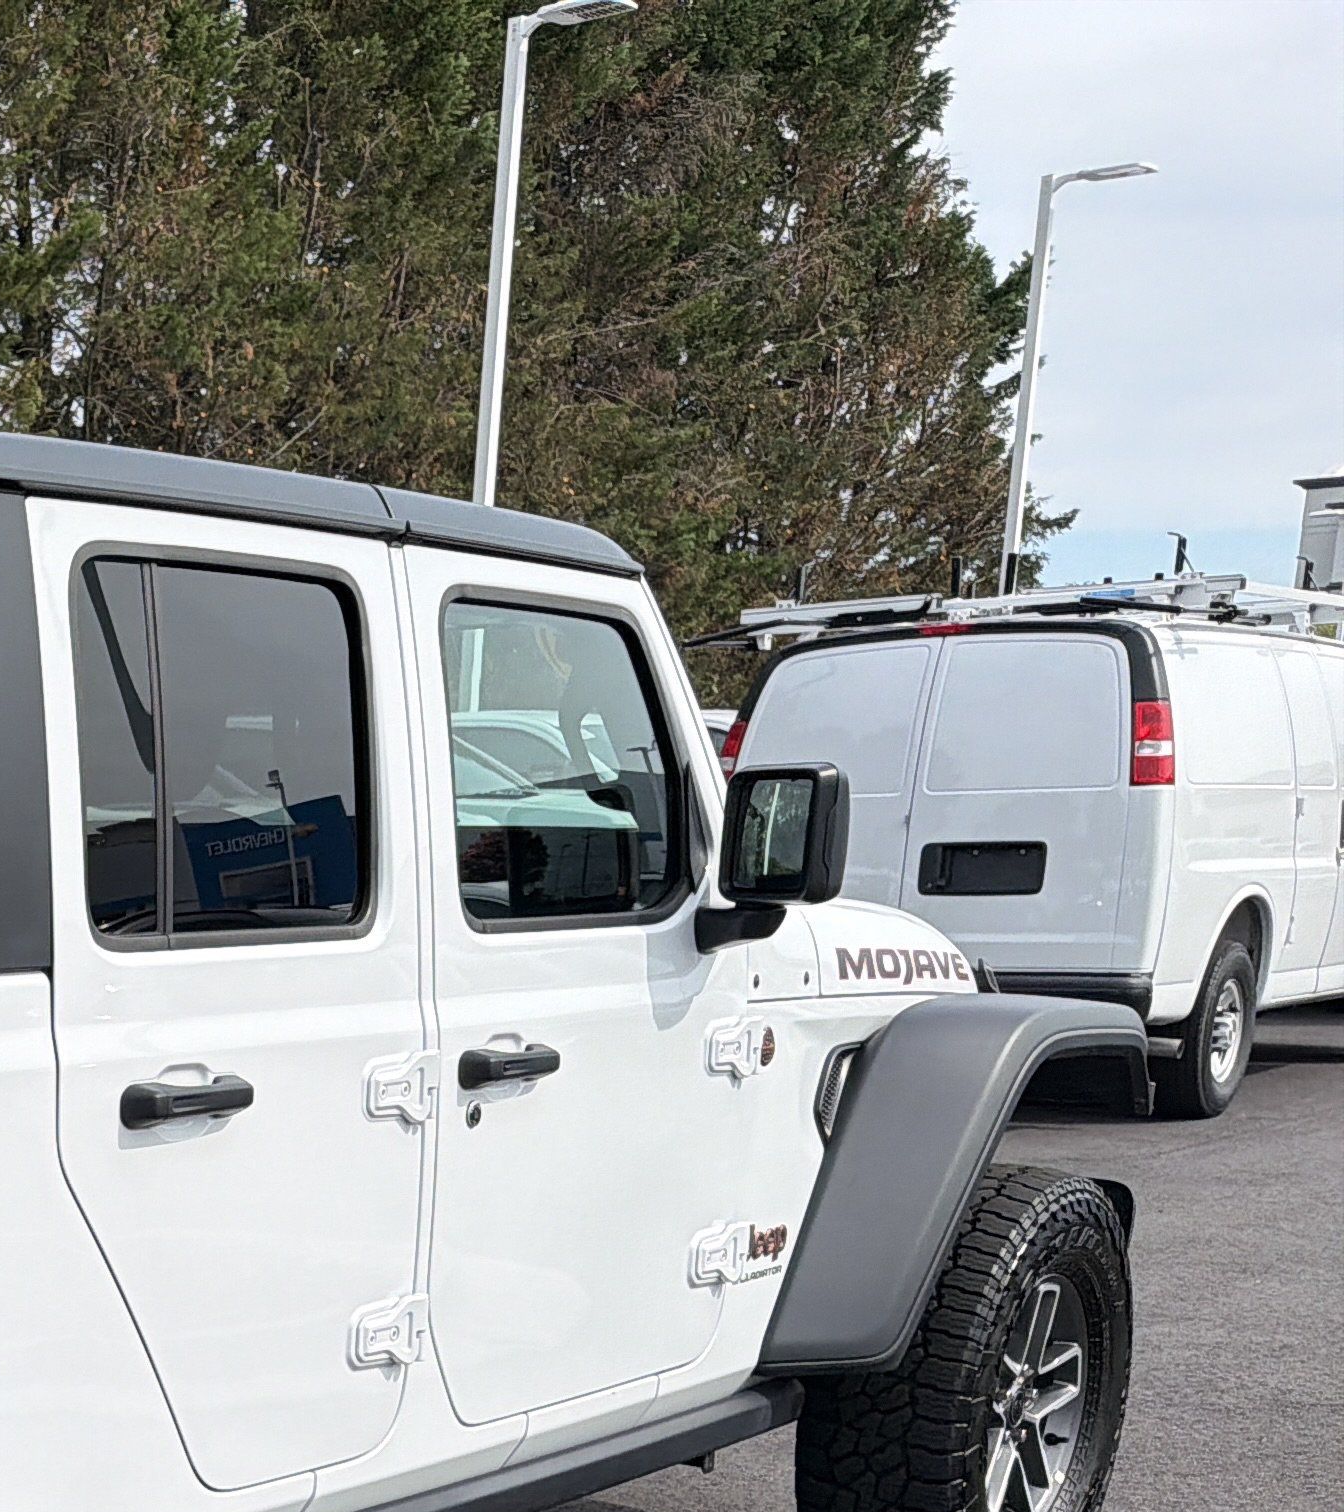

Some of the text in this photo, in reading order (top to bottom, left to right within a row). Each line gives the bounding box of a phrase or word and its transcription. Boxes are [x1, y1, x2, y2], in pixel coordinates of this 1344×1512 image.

[835, 947, 969, 985] MOJAVE
[745, 1223, 788, 1262] Jeep
[740, 1265, 782, 1283] LADIATOR
